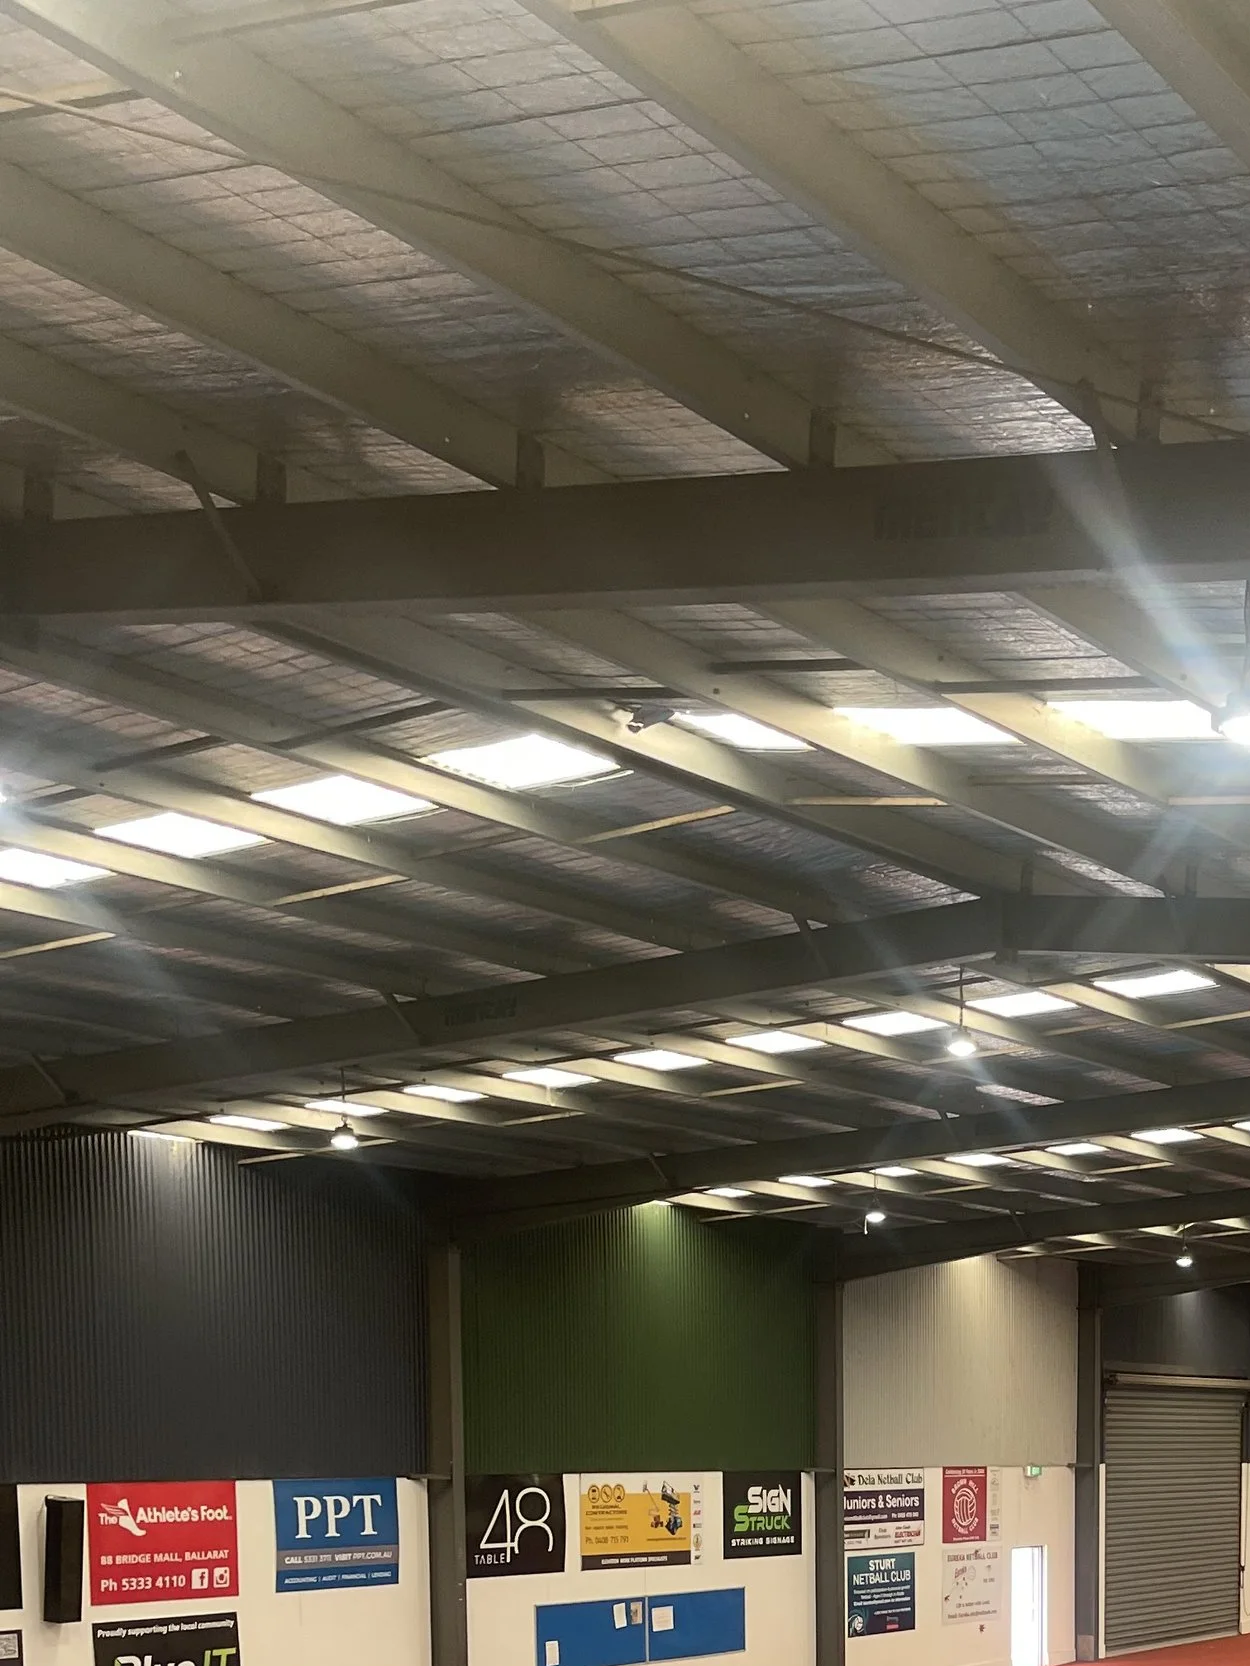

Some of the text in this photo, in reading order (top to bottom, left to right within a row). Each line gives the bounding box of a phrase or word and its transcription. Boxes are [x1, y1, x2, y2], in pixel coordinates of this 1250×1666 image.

[877, 1474, 903, 1485] Netball
[905, 1472, 923, 1484] Club
[878, 1494, 885, 1508] &
[886, 1493, 920, 1508] Seniors
[99, 1513, 118, 1525] The
[136, 1507, 199, 1523] Athlete's
[293, 1494, 382, 1539] PPT
[480, 1487, 553, 1563] 48
[731, 1536, 795, 1547] STRIKING SIGNAGE
[100, 1550, 230, 1565] 88 BRIDGE MALL, BALLARAT
[285, 1557, 303, 1565] CALL
[334, 1553, 352, 1561] VISIT
[474, 1553, 506, 1565] TABLE
[868, 1558, 896, 1571] STURT
[100, 1575, 186, 1592] Ph 5333 4110
[852, 1569, 911, 1586] NETBALL CLUB
[97, 1618, 235, 1638] Proudly supporting the local community
